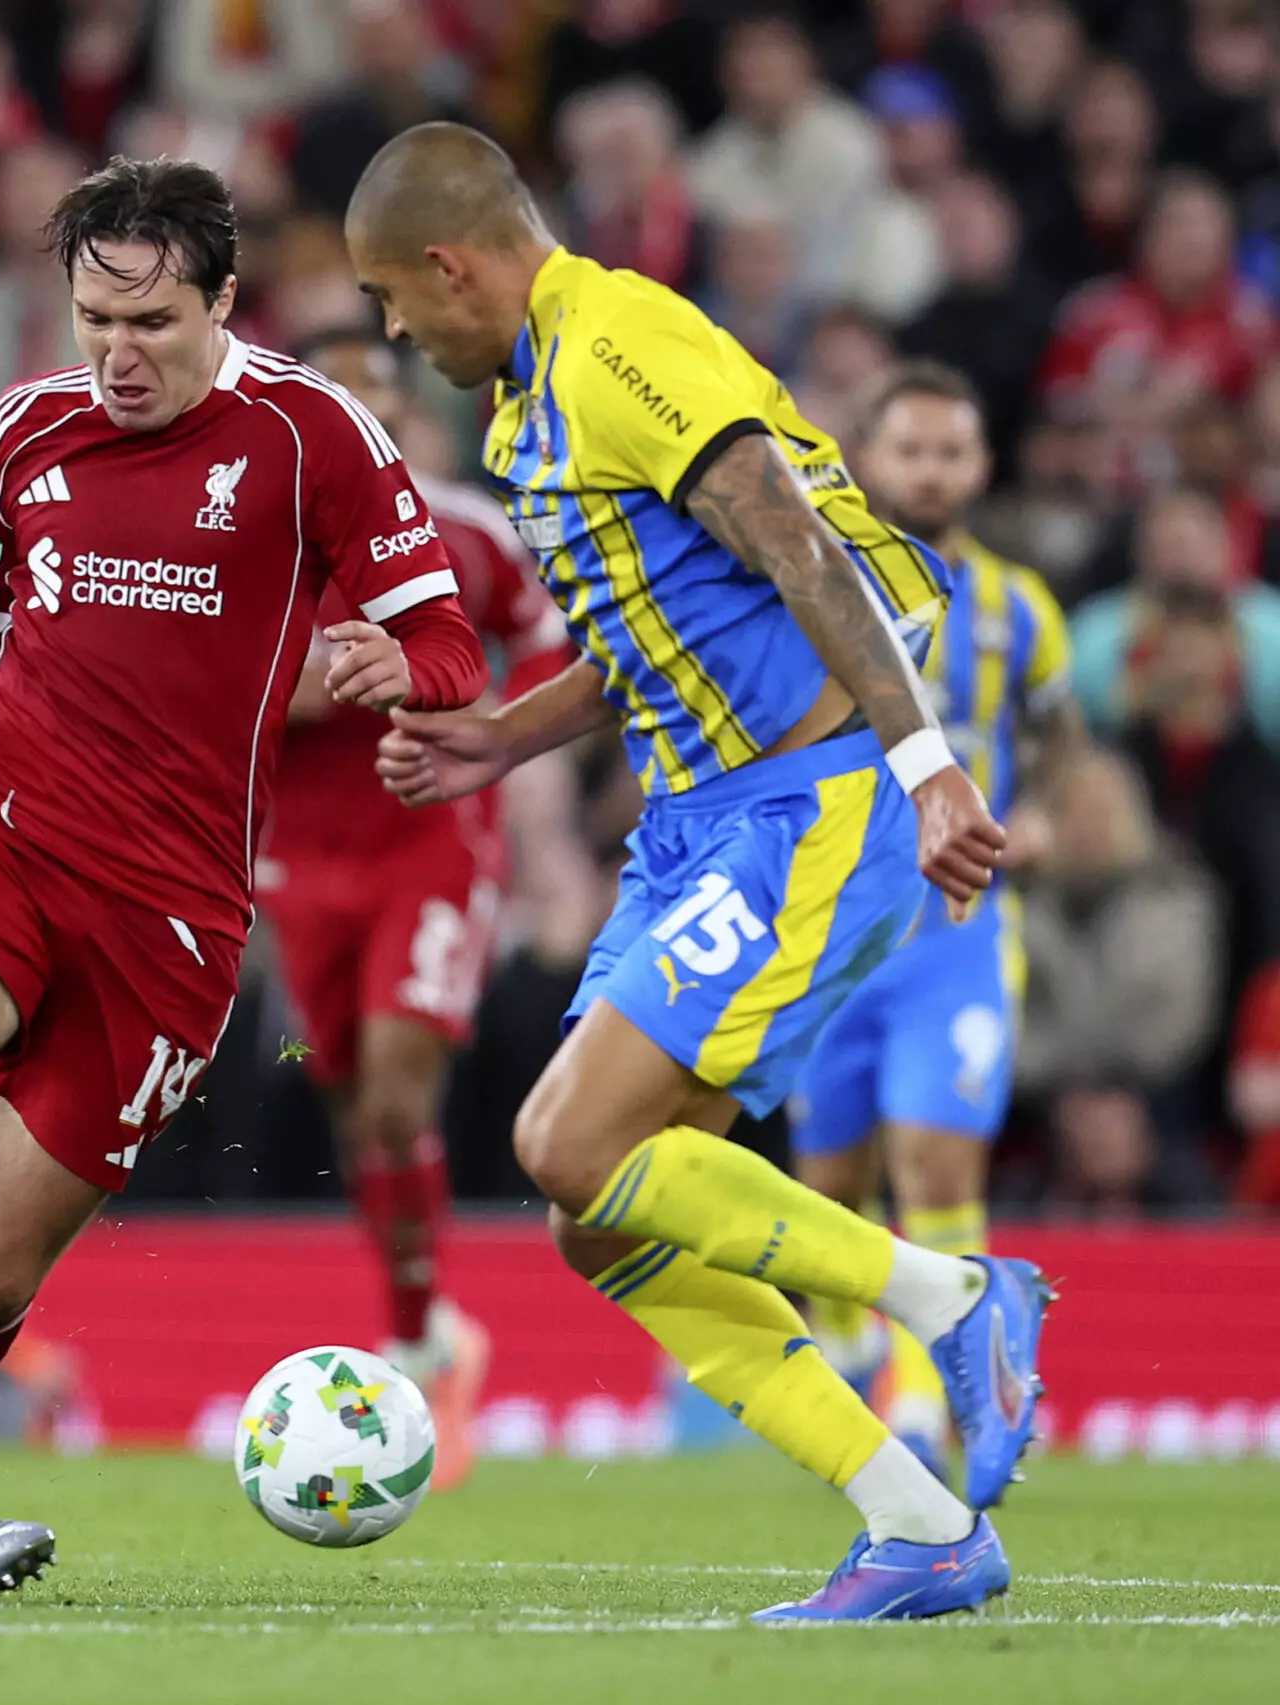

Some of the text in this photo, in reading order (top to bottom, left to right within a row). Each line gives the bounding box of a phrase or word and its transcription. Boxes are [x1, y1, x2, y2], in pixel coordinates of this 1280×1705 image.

[591, 337, 692, 436] GARMIN
[71, 578, 223, 617] chartered
[72, 551, 217, 590] standard
[649, 871, 769, 976] 15
[118, 1034, 207, 1126] 14
